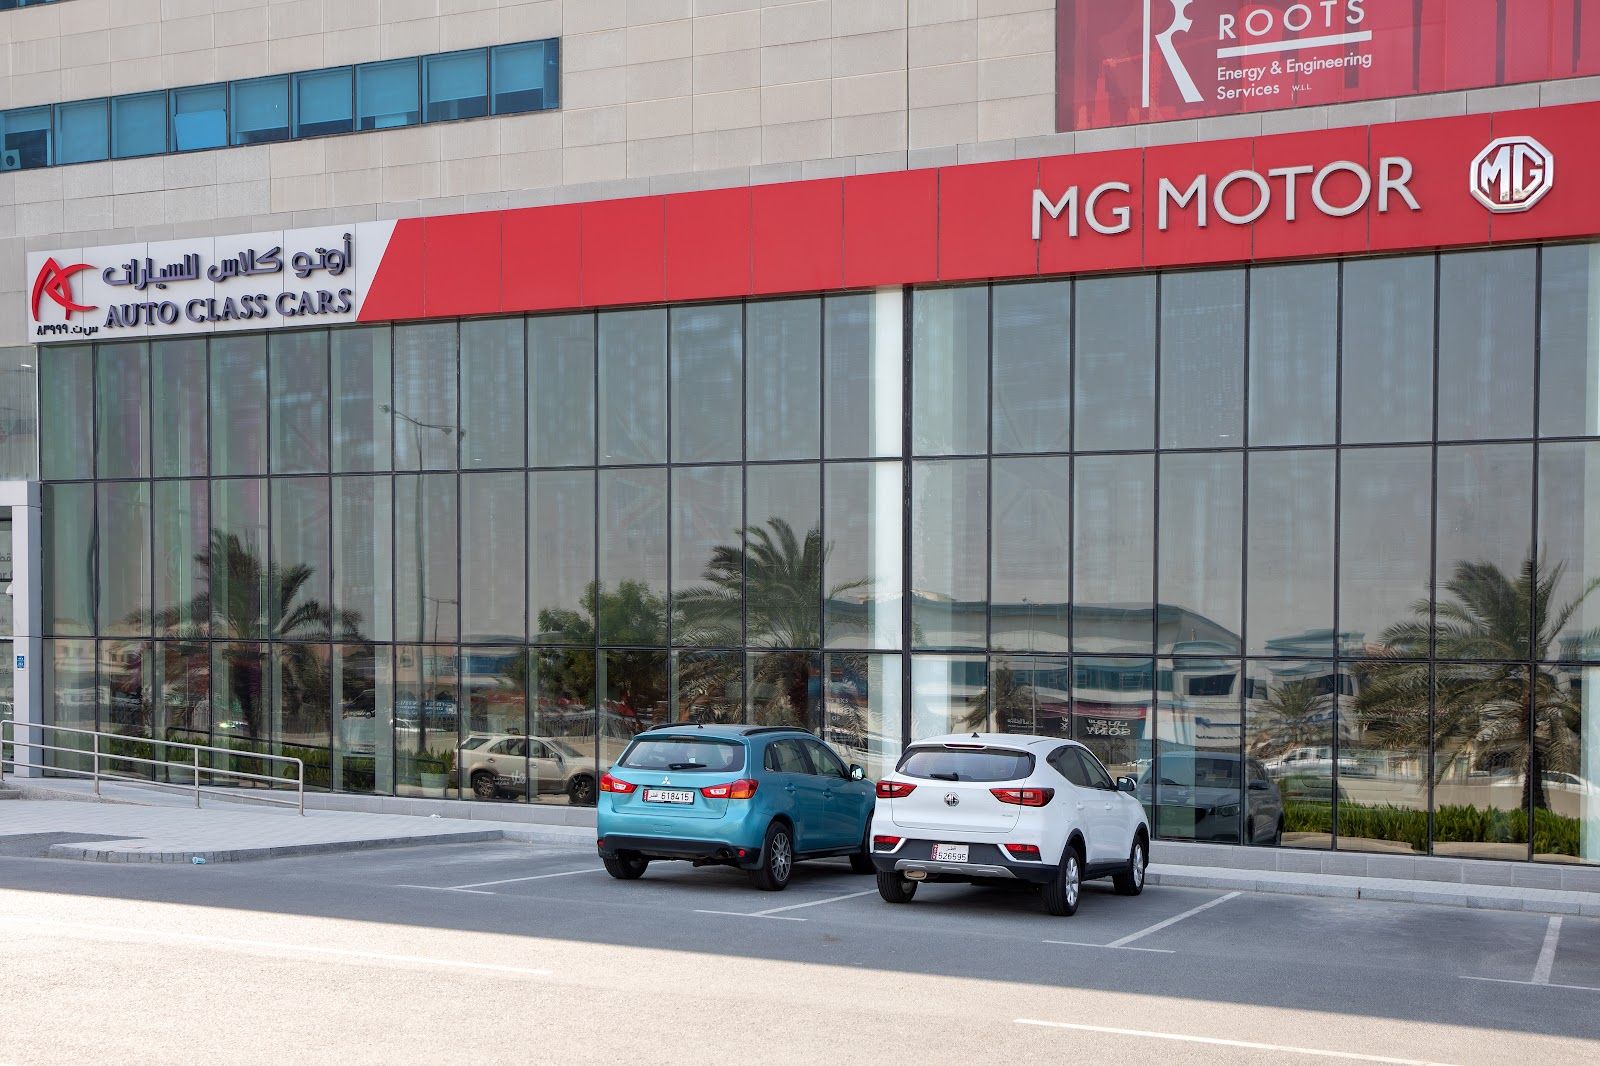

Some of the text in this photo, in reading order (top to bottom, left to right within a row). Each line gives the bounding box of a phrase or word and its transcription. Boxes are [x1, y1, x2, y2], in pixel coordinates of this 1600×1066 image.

[1218, 0, 1366, 41] ROOTS
[1217, 52, 1372, 81] Energy & Engineering
[1216, 83, 1280, 100] Services
[1477, 142, 1546, 206] MG
[1031, 156, 1422, 240] MG MOTOR
[102, 232, 352, 290] أوتو كلاس للسيارات
[103, 288, 352, 328] AUTO CLASS CARS
